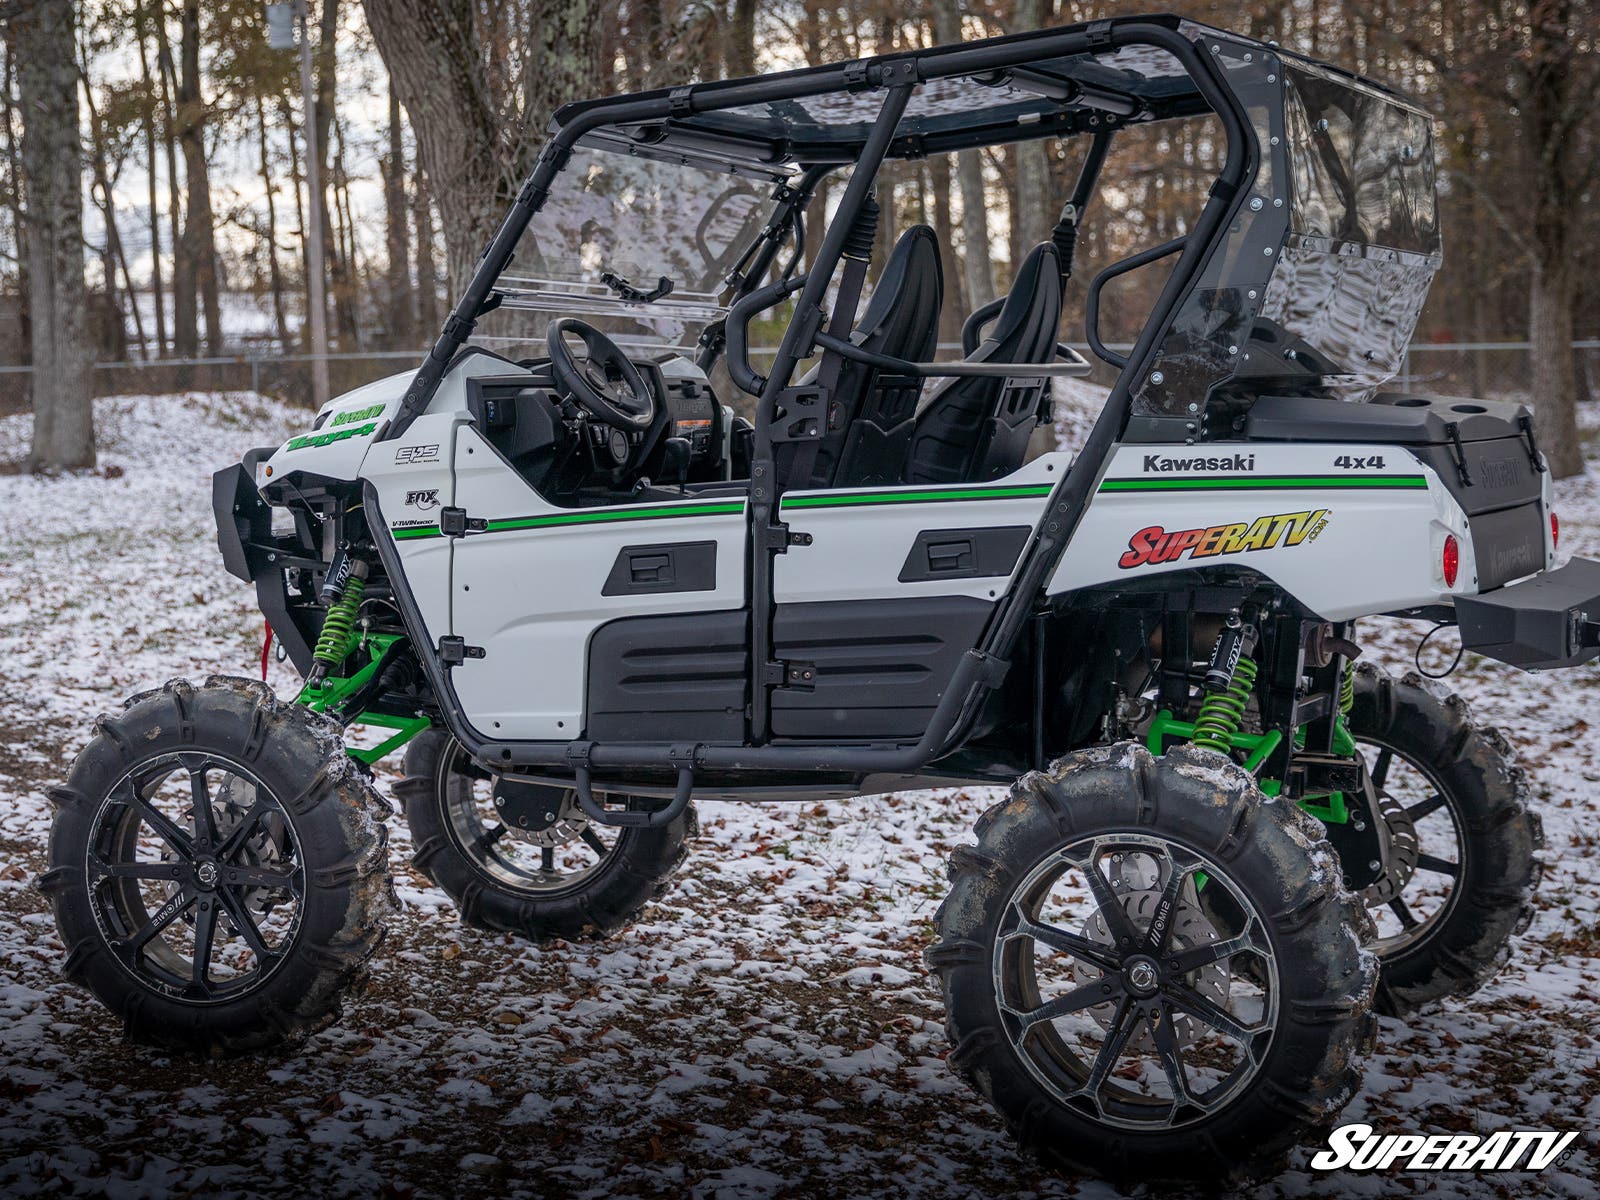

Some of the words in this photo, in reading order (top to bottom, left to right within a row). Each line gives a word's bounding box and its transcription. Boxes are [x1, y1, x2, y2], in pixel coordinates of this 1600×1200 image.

[395, 444, 440, 461] EPS
[1143, 454, 1255, 472] Kawasaki
[1333, 455, 1386, 469] 4x4
[405, 489, 440, 510] FOX
[1117, 508, 1329, 570] SUPERATV
